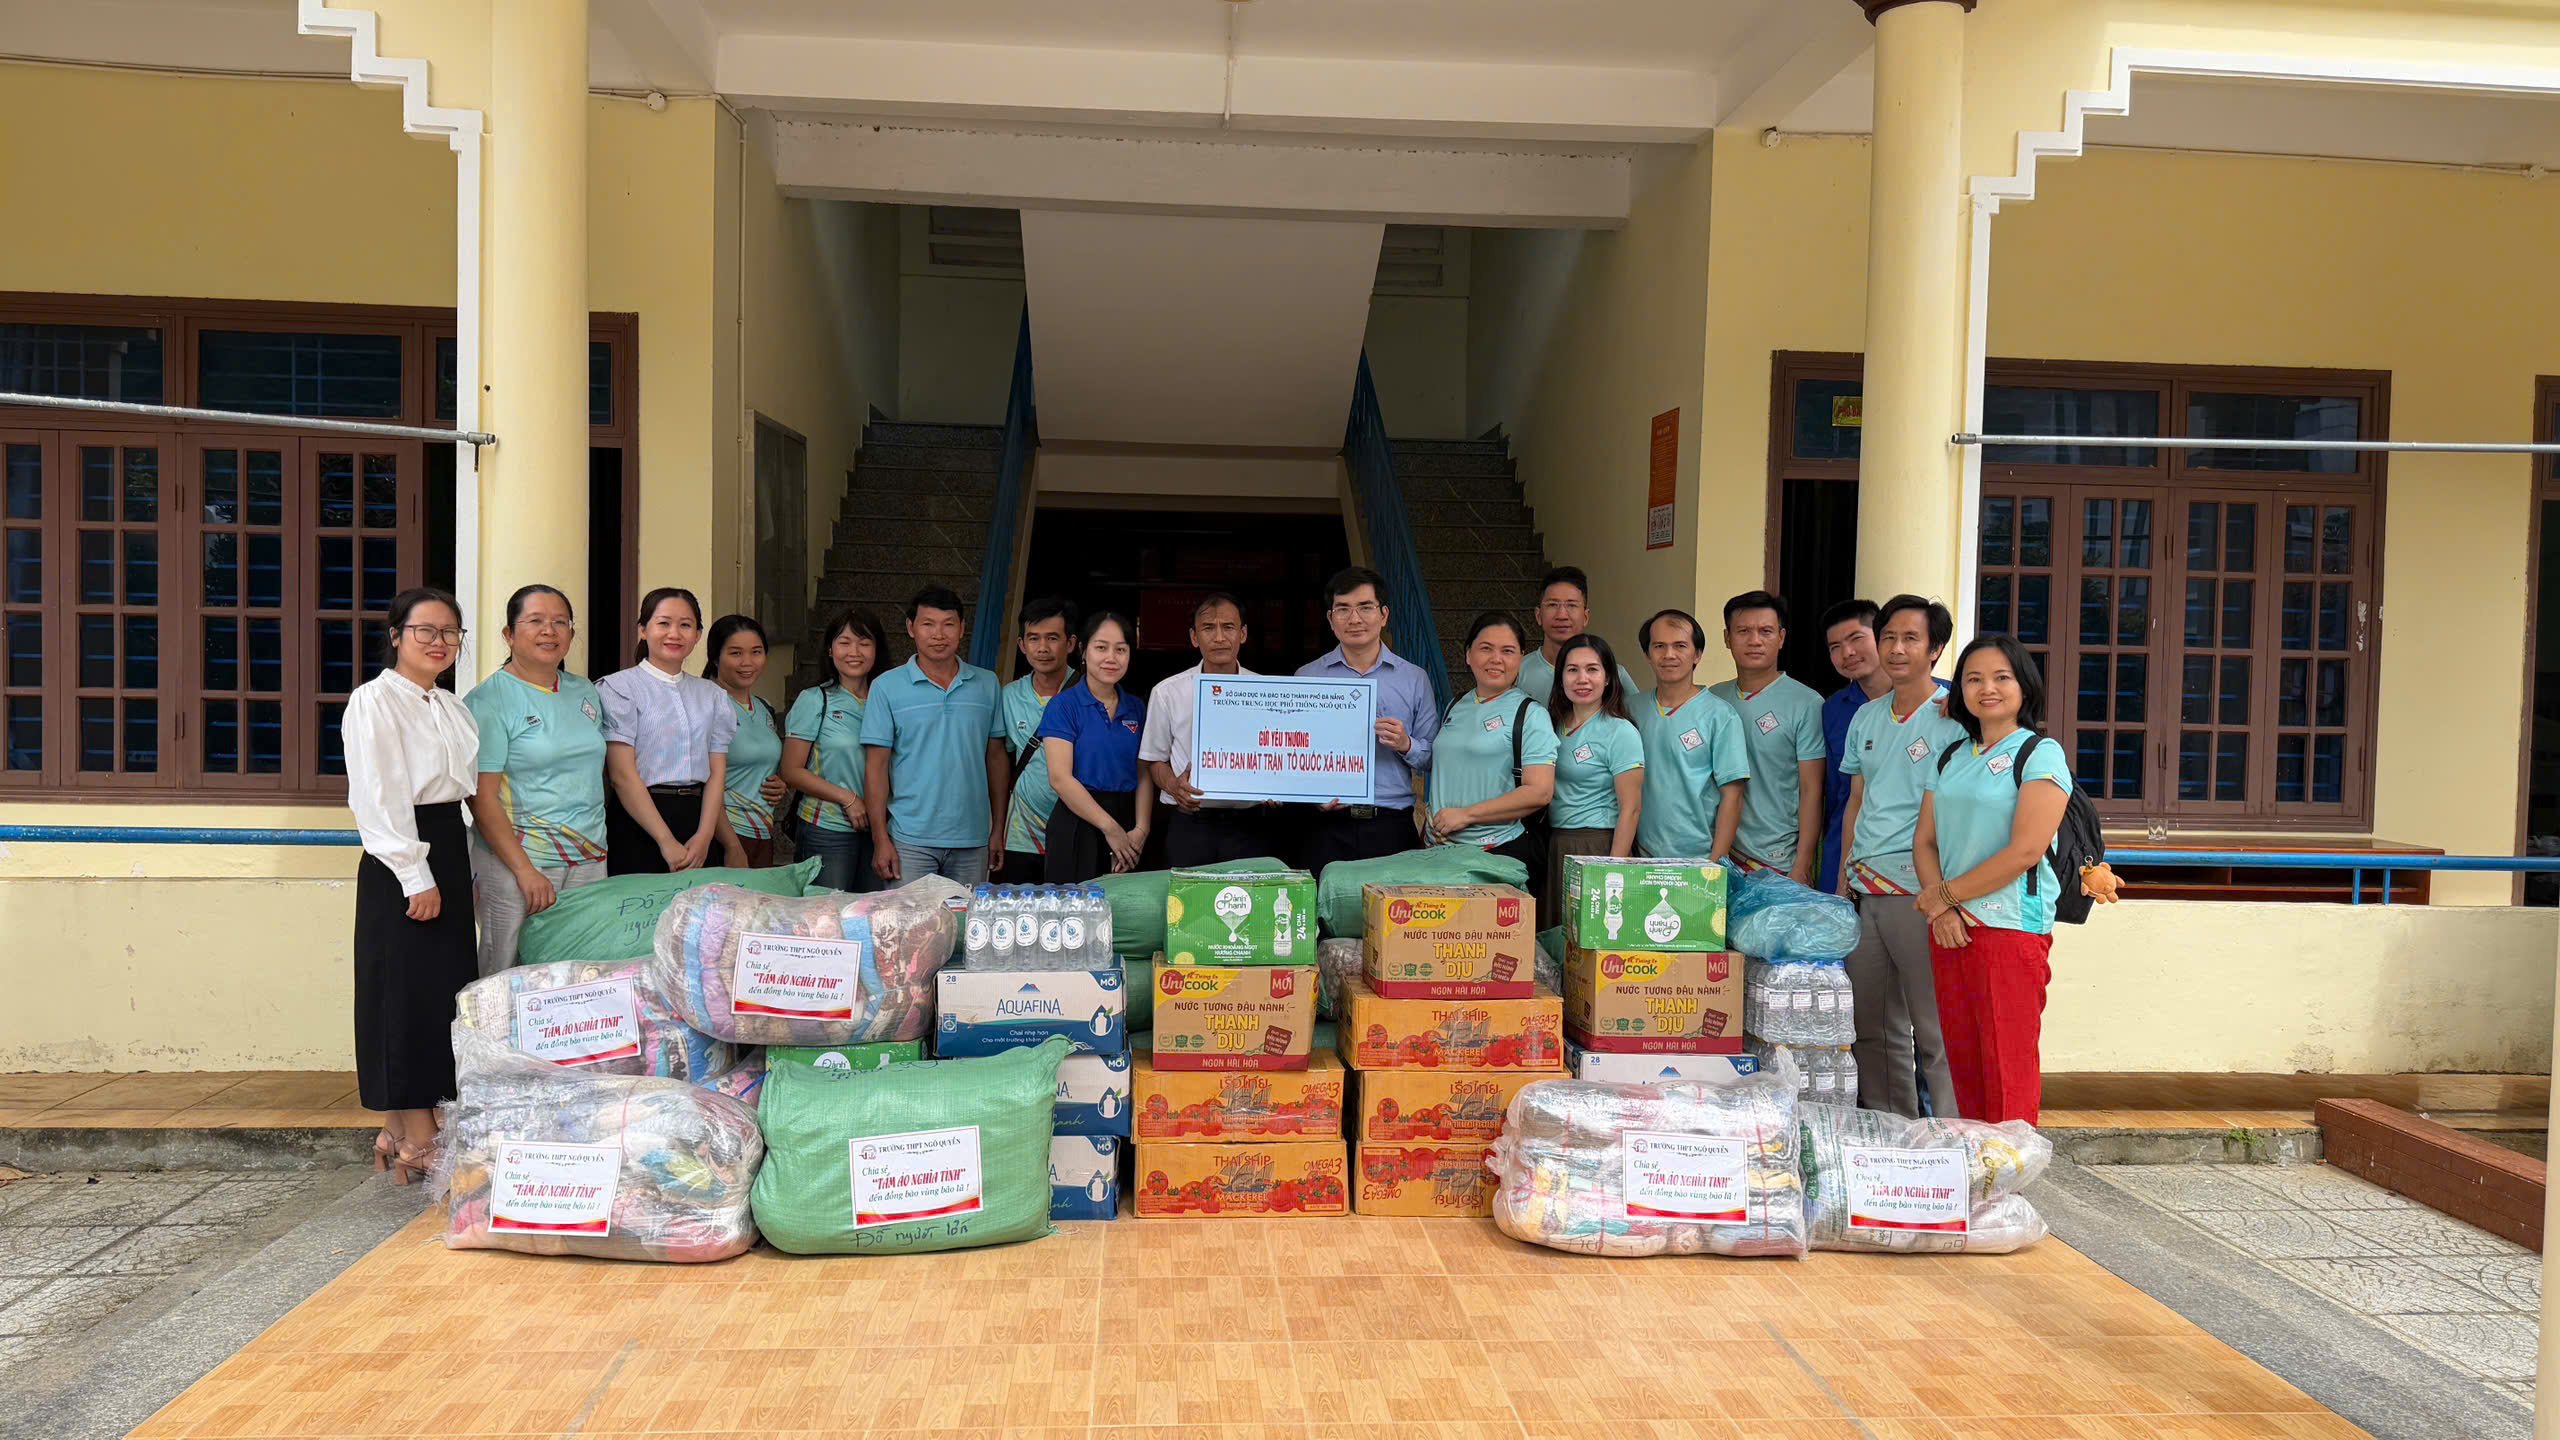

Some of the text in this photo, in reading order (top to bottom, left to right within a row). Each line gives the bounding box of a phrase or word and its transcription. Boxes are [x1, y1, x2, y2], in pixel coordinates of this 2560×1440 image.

[1234, 690, 1247, 698] GIÁO
[1213, 698, 1240, 706] TRƯỜNG
[1295, 700, 1318, 709] THÔNG
[1319, 701, 1333, 709] NGÔ
[1334, 700, 1357, 710] QUYỀN
[1259, 726, 1310, 748] GỬI YÊU THƯƠNG
[1202, 747, 1364, 775] ĐẾN ỦY BAN MẶT TRẬN TỔ QUỐC XÃ HÀ NHA
[1591, 888, 1600, 901] 24
[1498, 903, 1518, 919] MỚI
[1296, 926, 1306, 940] 24
[1403, 930, 1511, 941] NƯỚC TƯƠNG ĐẬU NÀNH
[764, 944, 843, 956] TRƯỜNG THPT NGÔ QUYỀN
[1433, 943, 1487, 959] THANH
[745, 960, 761, 969] Chia
[1446, 961, 1474, 979] DỊU
[1708, 959, 1727, 975] MỚI
[776, 971, 789, 985] ÁO
[790, 973, 816, 987] NGHĨA
[1272, 975, 1293, 991] MỚI
[748, 985, 762, 994] đến
[763, 985, 781, 996] đồng
[782, 987, 795, 997] bào
[796, 990, 814, 1000] vùng
[815, 990, 829, 999] bão
[1431, 986, 1486, 995] NGON HÀI HÒA
[1616, 985, 1721, 995] NƯỚC TƯƠNG ĐẬU NÀNH
[996, 998, 1062, 1016] AQUAFINA
[1174, 1001, 1285, 1012] NƯỚC TƯƠNG ĐẬU NÀNH
[1645, 998, 1698, 1014] THANH
[1204, 1014, 1260, 1030] THANH
[1462, 1010, 1488, 1022] SHIP
[574, 1016, 599, 1034] NGHĨA
[1657, 1016, 1685, 1035] DỊU
[1024, 1029, 1035, 1037] nhẹ
[1216, 1032, 1246, 1051] DỊU
[1642, 1040, 1696, 1050] NGON HÀI HÒA
[1202, 1057, 1259, 1068] NGON HÀI HÒA
[1590, 1056, 1601, 1064] 28
[879, 1136, 961, 1153] TRƯỜNG THPT NGÔ QUYỀN
[1245, 1155, 1271, 1167] SHIP
[862, 1166, 879, 1176] Chia
[897, 1172, 910, 1188] ÁO
[911, 1169, 938, 1186] NGHĨA
[869, 1192, 883, 1202] đến
[884, 1190, 903, 1200] đồng
[904, 1188, 919, 1198] bào
[920, 1187, 939, 1197] vùng
[940, 1185, 955, 1194] bão
